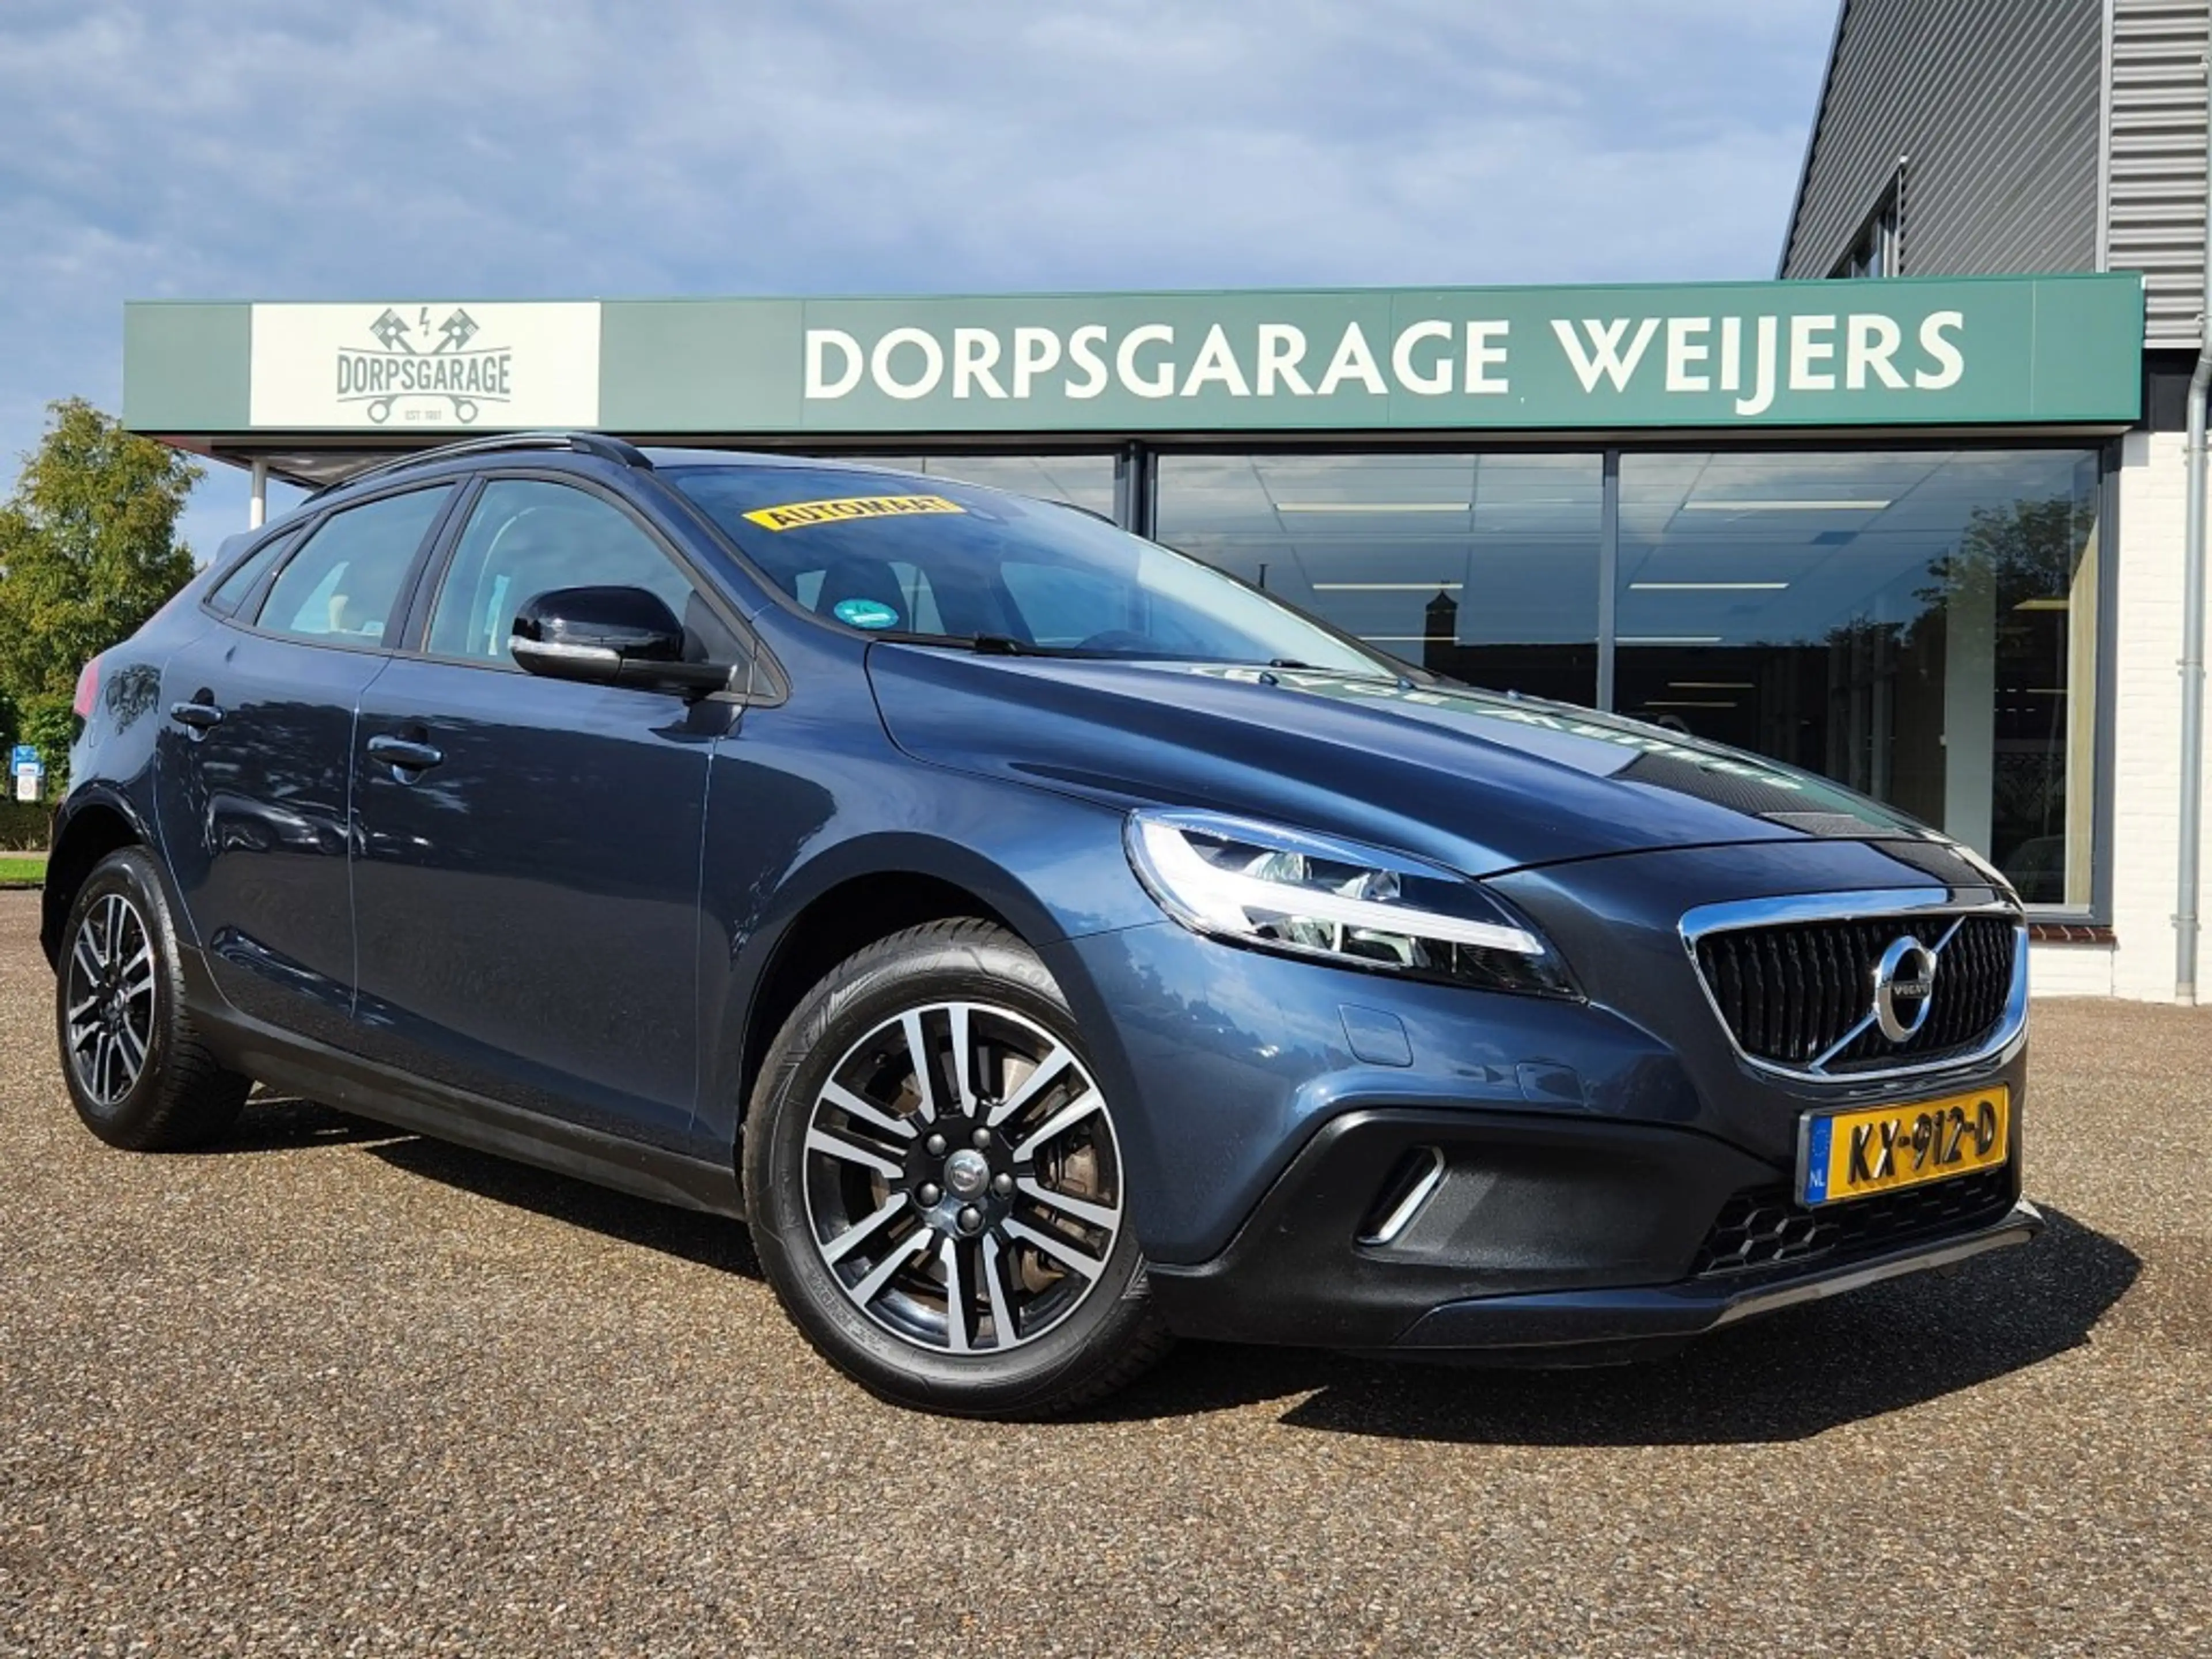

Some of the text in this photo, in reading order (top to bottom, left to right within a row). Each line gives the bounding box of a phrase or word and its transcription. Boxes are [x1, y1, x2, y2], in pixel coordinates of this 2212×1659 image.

[336, 354, 512, 395] DORPSGARAGE
[805, 311, 1964, 415] DORPSGARAGE WEIJERS
[767, 498, 952, 527] AUTOMAAT
[1848, 1100, 1997, 1185] KX-912-D
[1809, 1169, 1825, 1187] NL
